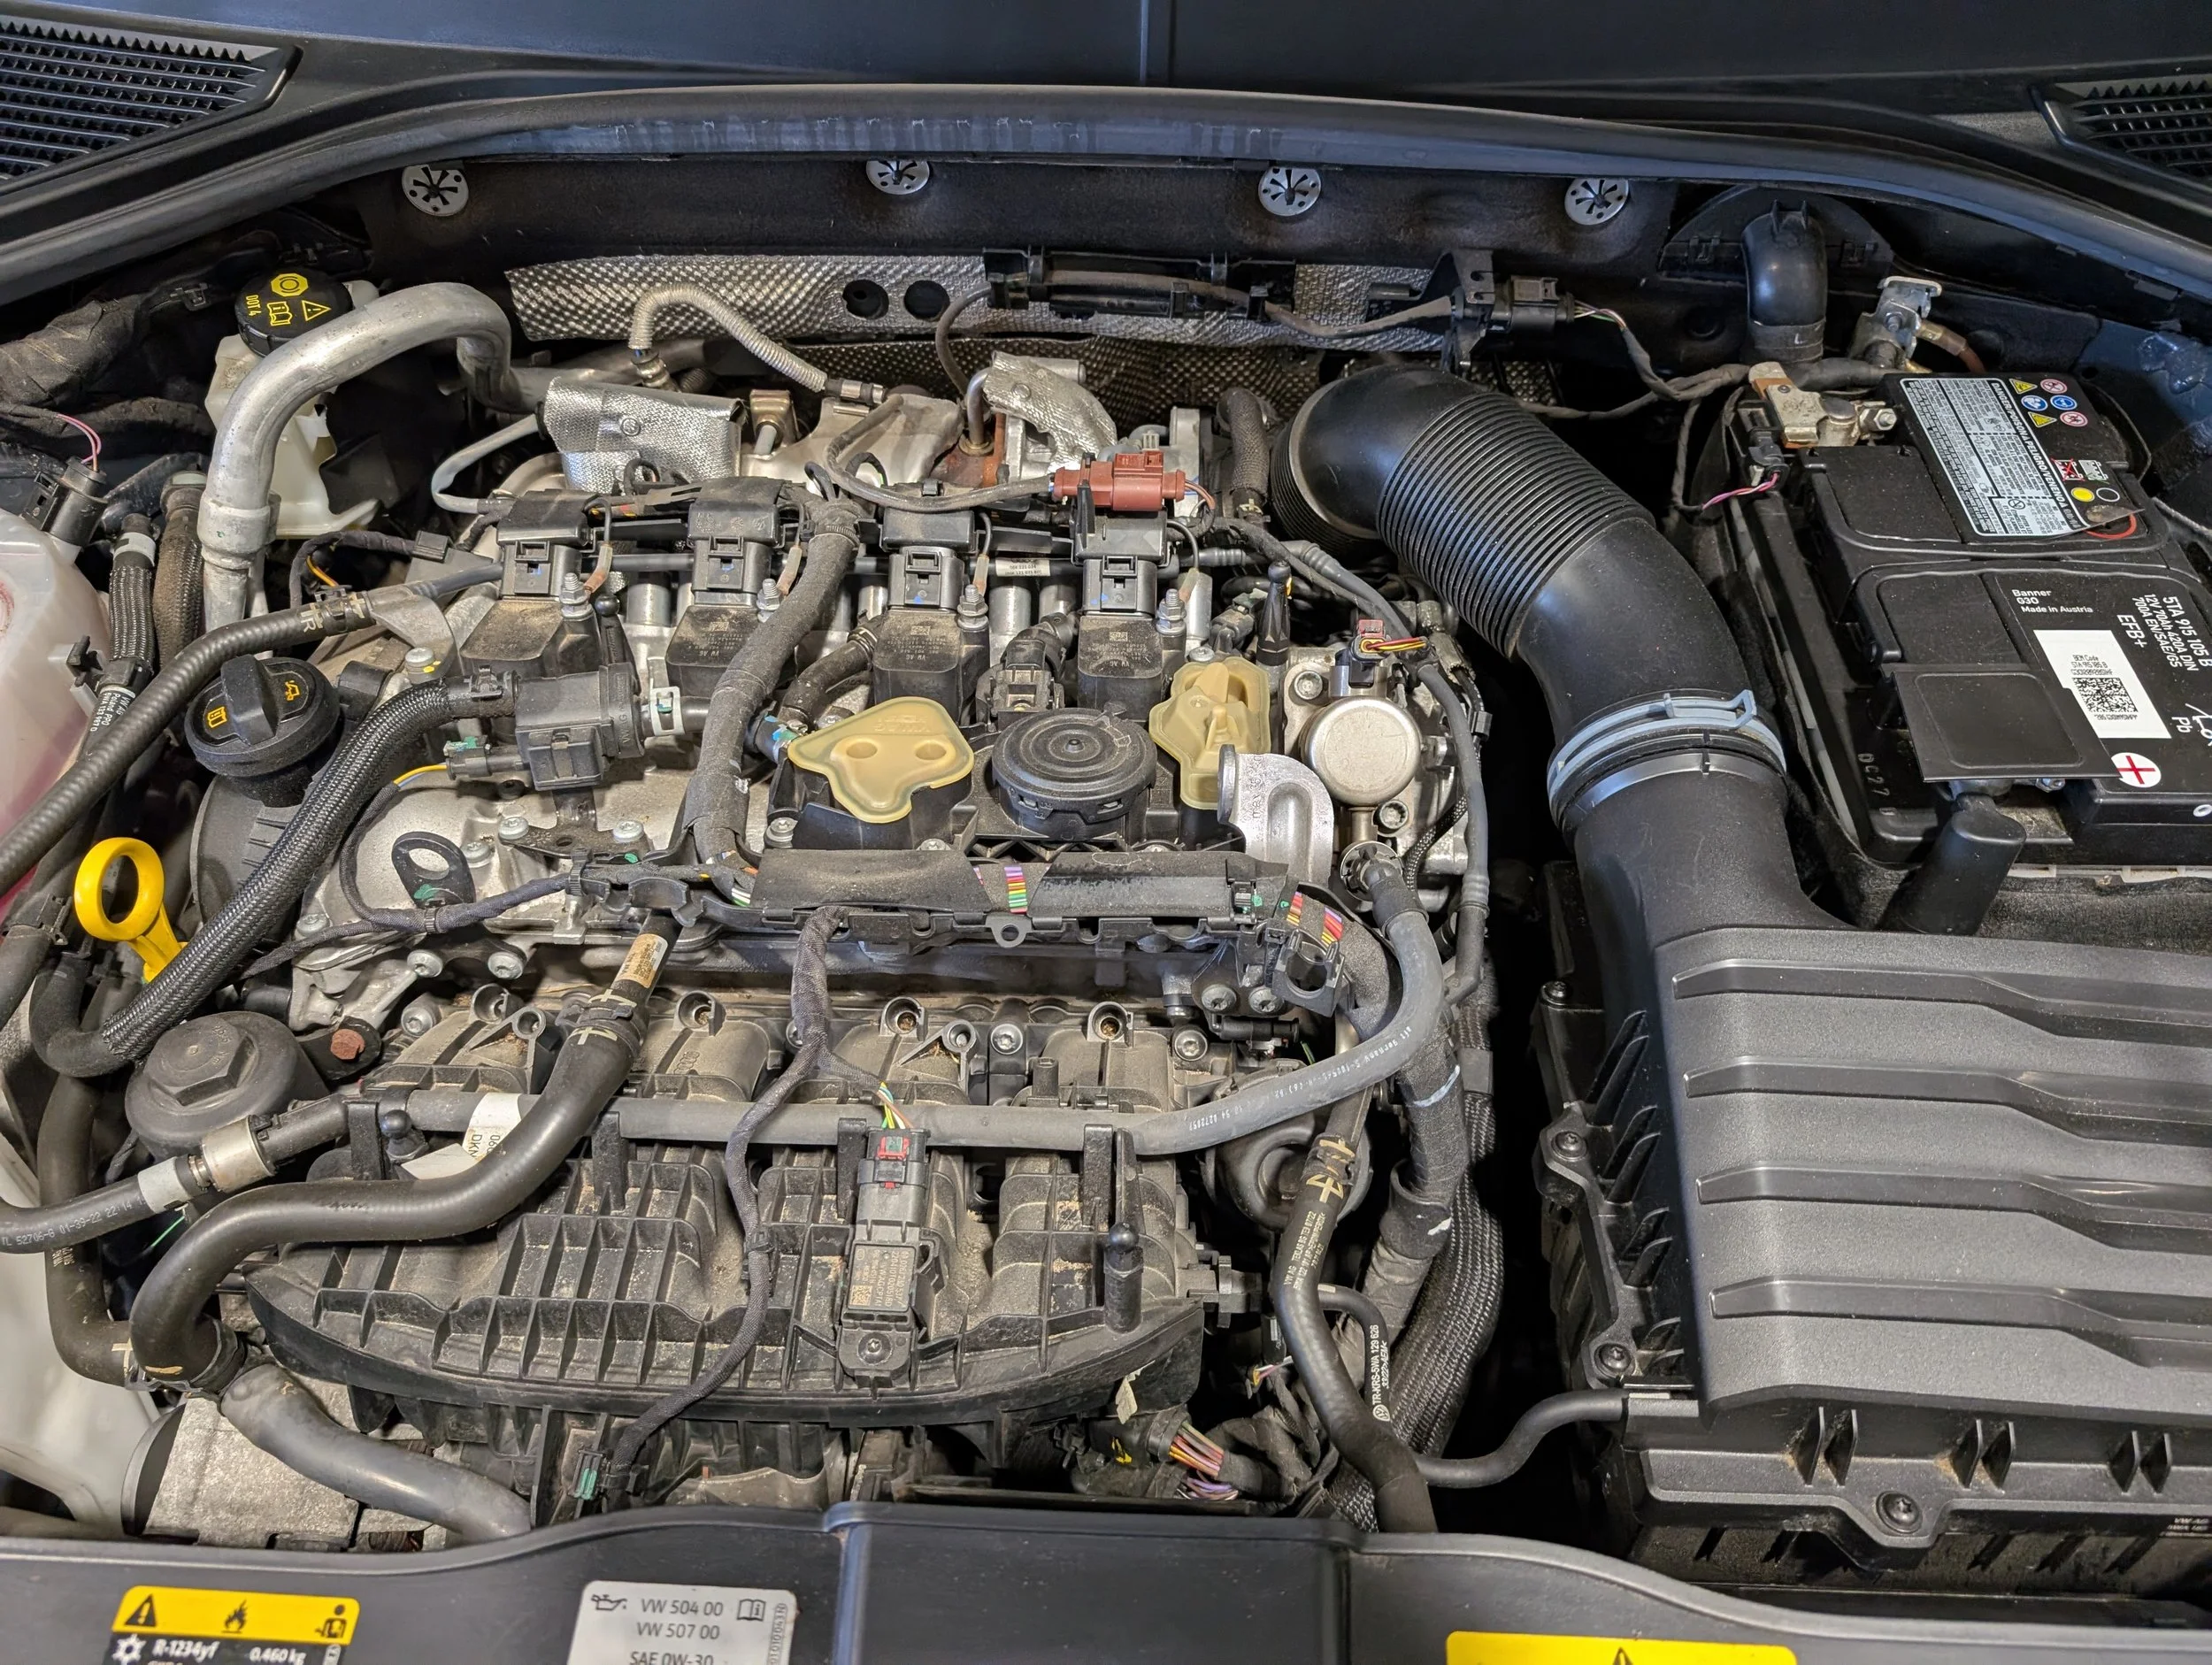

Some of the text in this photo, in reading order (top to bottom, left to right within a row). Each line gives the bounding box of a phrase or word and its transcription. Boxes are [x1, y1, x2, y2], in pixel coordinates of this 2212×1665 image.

[245, 295, 261, 309] DOT
[2162, 596, 2185, 618] 5TA
[2116, 614, 2147, 648] EFB+
[2131, 596, 2183, 667] 700A EN/SAE/GS
[2144, 594, 2200, 671] 12V 70Ah 420A DIN
[2175, 618, 2198, 636] 915
[2186, 638, 2209, 656] 105
[2171, 717, 2193, 733] Pb
[1370, 1324, 1379, 1339] 626
[1371, 1339, 1379, 1354] 129
[1371, 1354, 1382, 1405] TR-KRS-5WA
[641, 1599, 724, 1615] VW 504 00
[636, 1622, 720, 1639] VW 507 00
[151, 1638, 220, 1662] R-1234yf
[629, 1651, 714, 1665] SAE 0W-30
